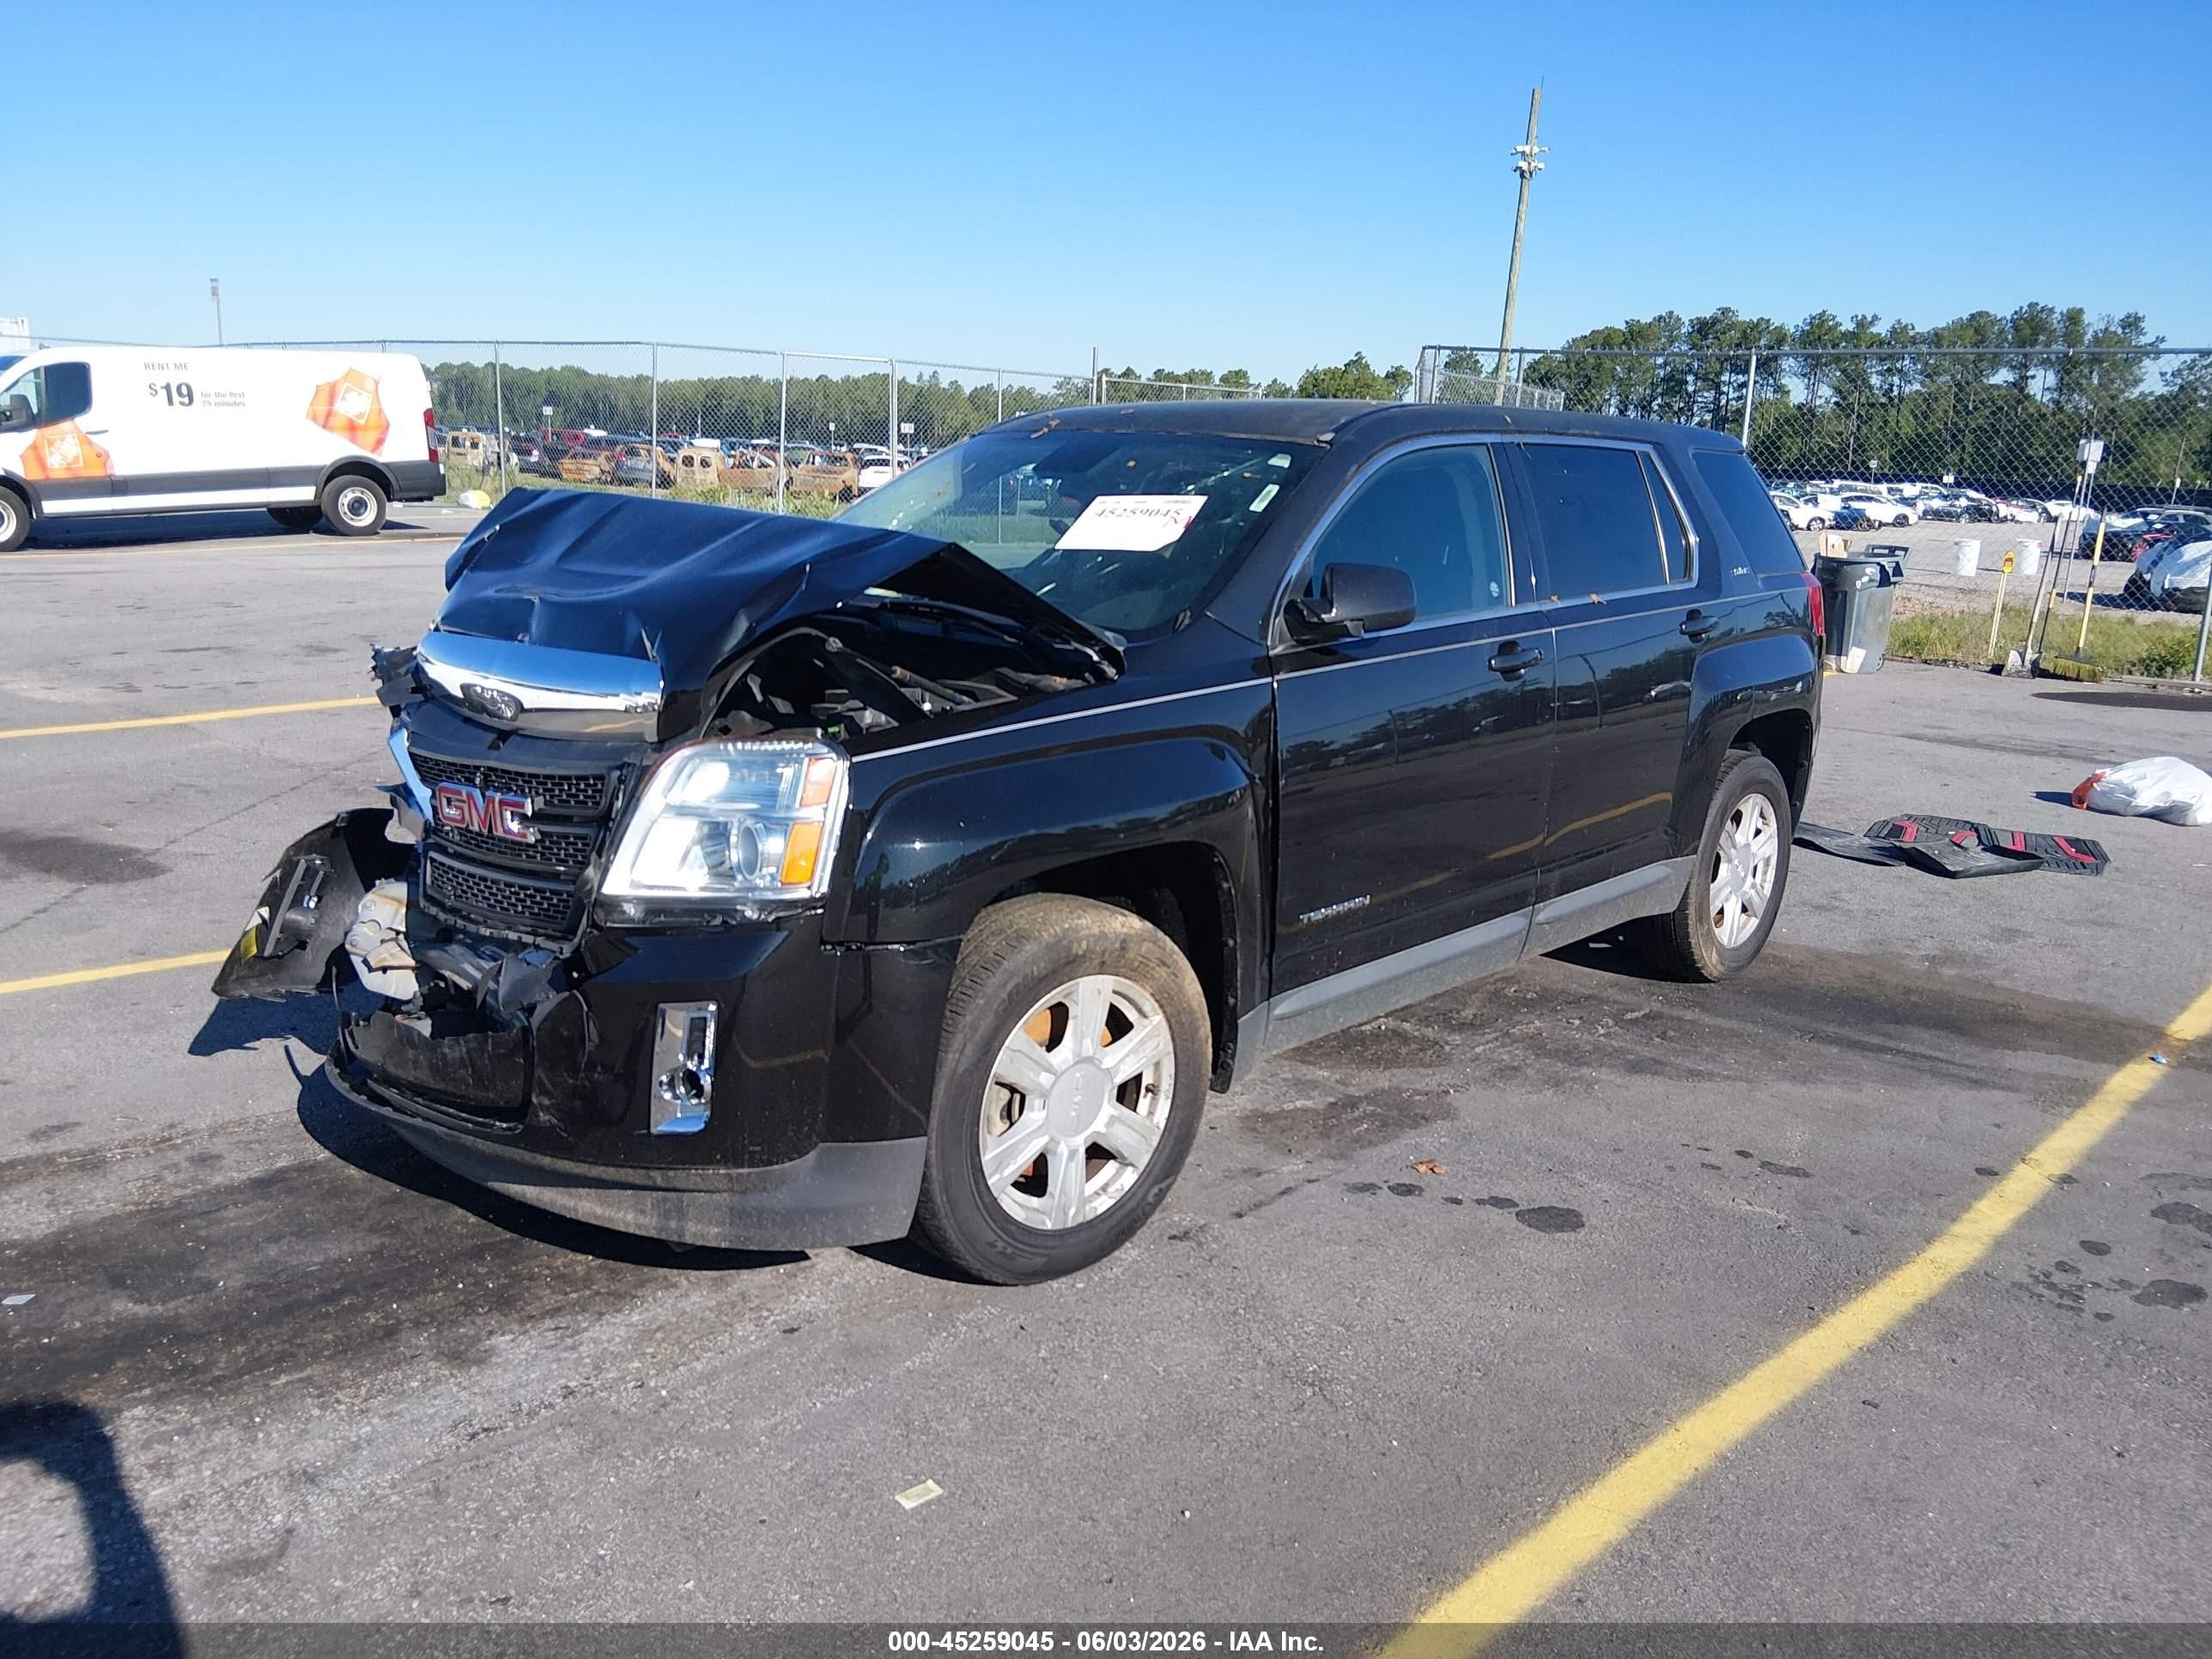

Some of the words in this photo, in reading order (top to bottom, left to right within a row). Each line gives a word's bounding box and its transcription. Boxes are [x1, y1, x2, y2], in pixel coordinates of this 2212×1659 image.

[144, 362, 171, 371] RENT
[173, 362, 189, 371] ME
[436, 781, 535, 844] GMC
